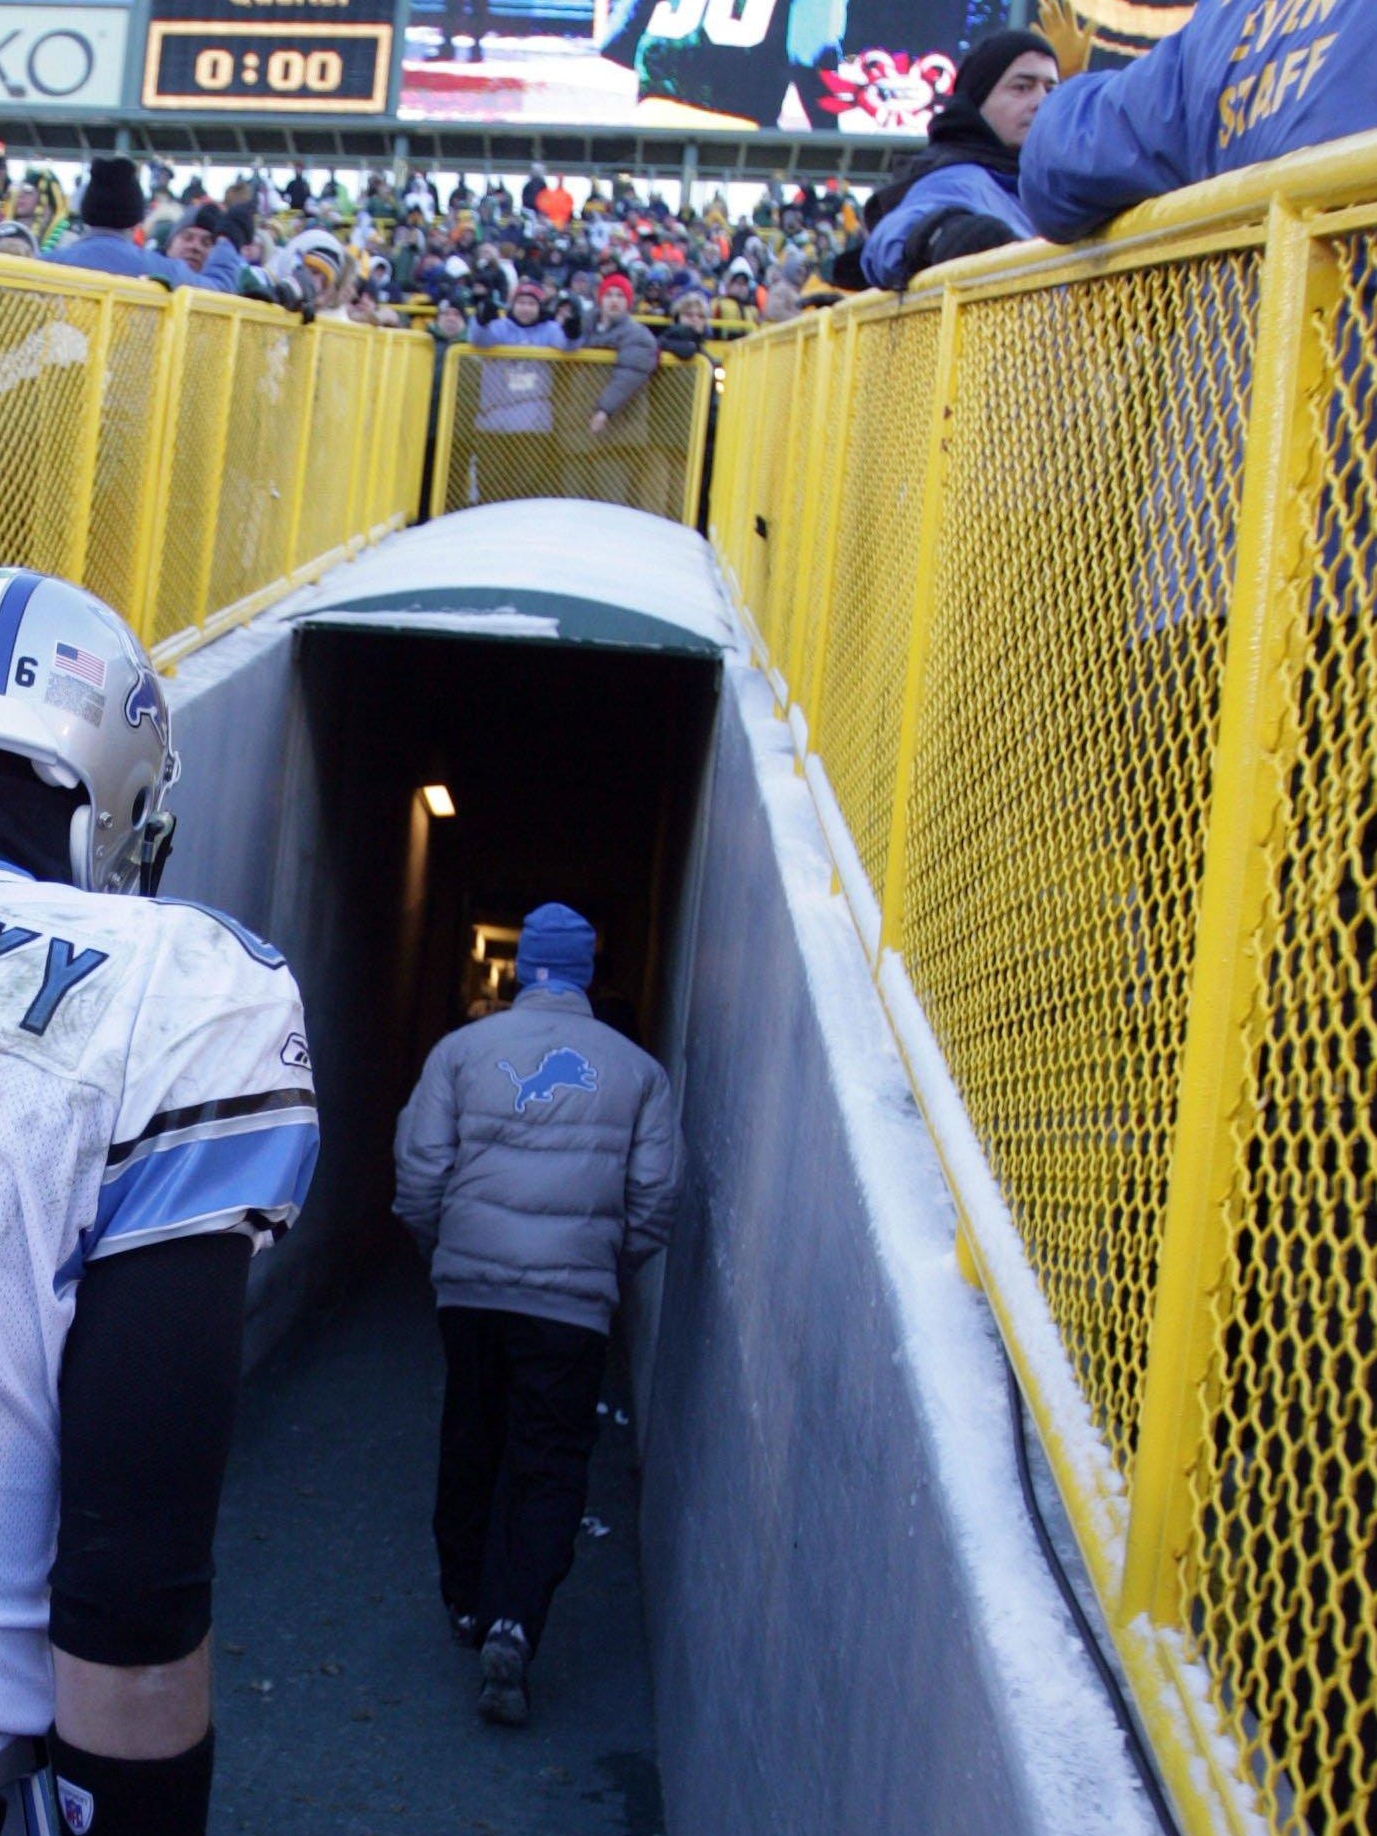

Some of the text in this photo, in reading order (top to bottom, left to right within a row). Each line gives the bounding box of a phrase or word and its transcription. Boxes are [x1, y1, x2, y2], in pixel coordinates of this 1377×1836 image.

[195, 49, 343, 92] 0:00
[1219, 32, 1339, 149] STAFF
[15, 656, 39, 688] 6
